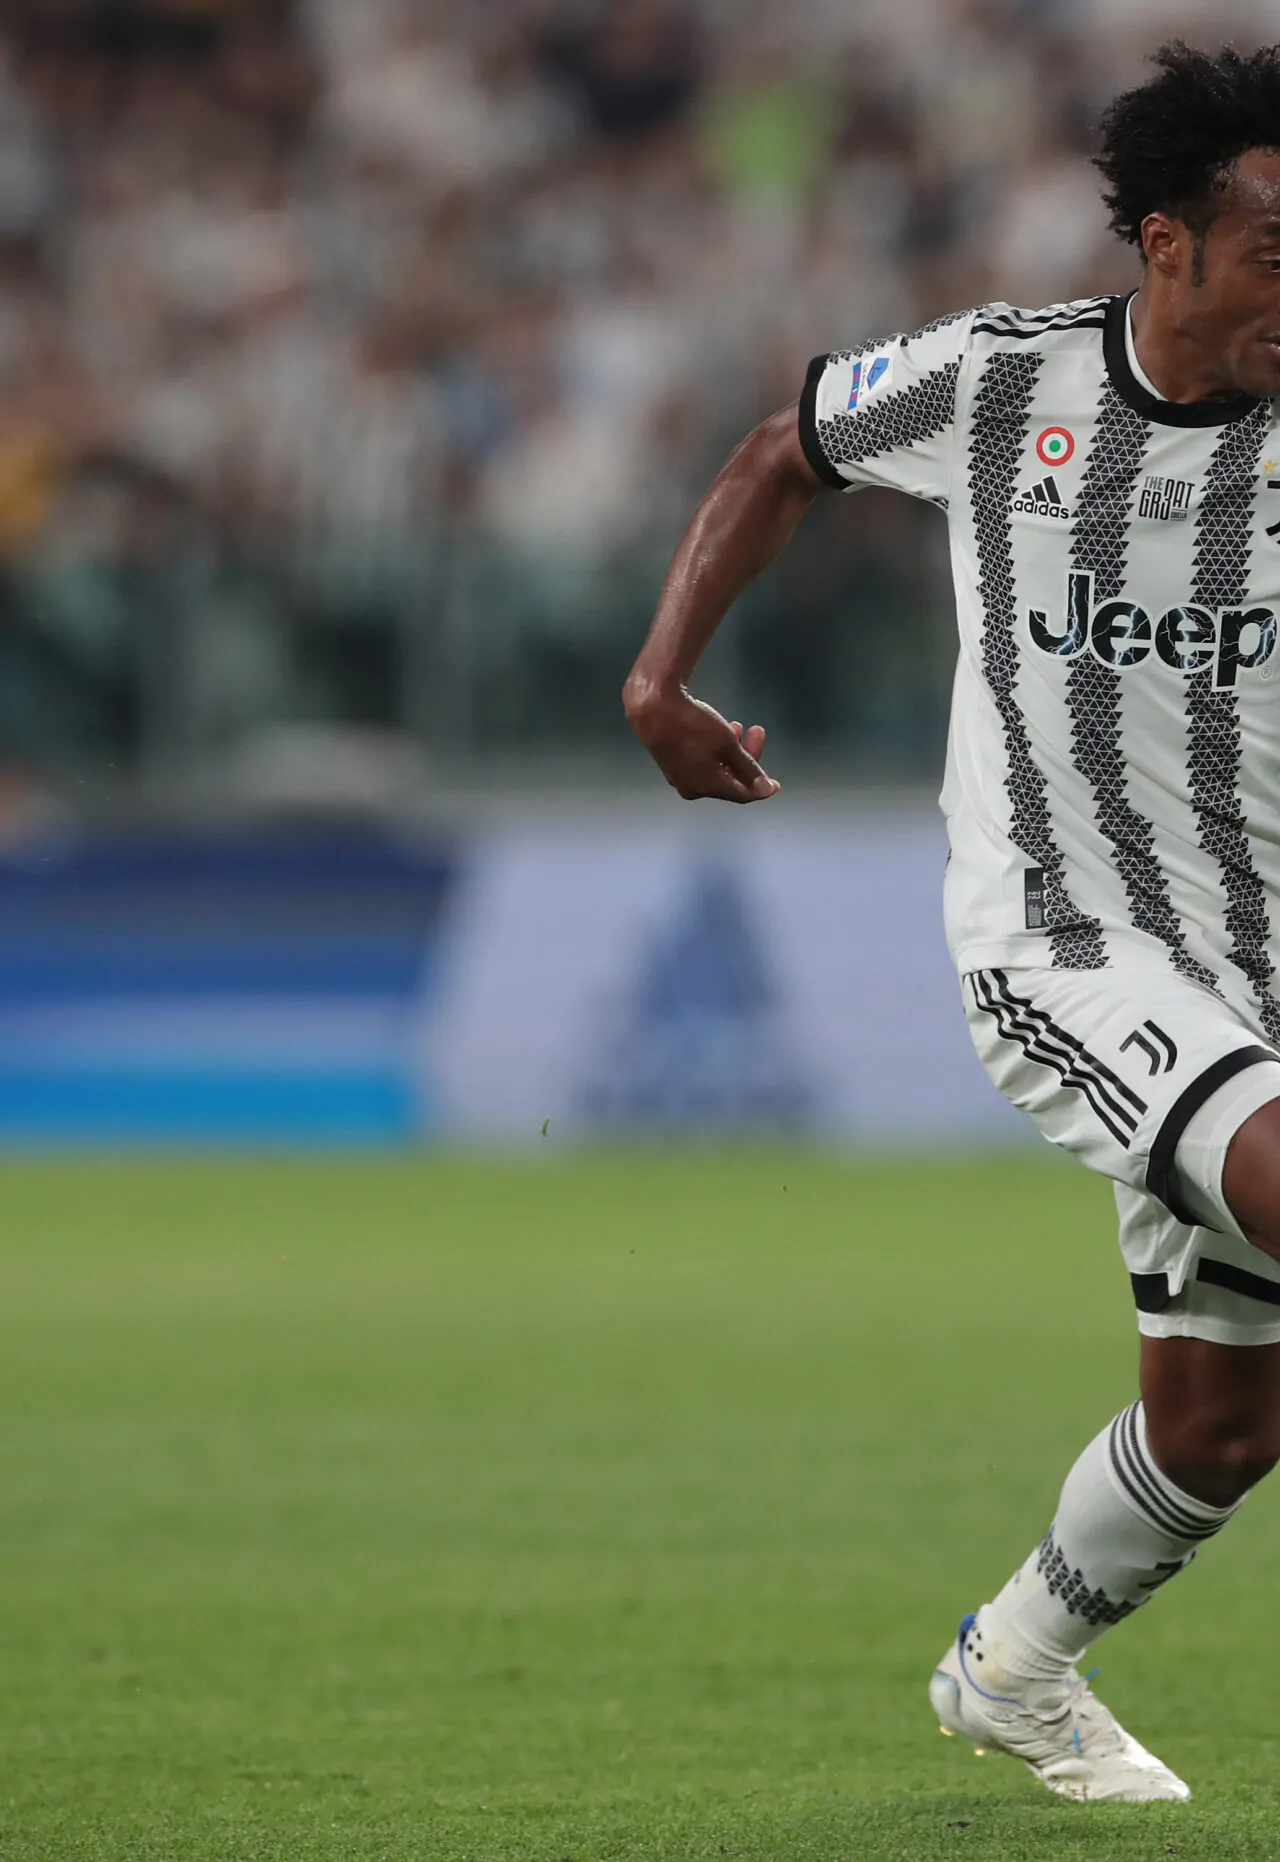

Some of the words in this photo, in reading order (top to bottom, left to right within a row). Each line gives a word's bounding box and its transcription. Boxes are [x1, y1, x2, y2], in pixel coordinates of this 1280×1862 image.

[1143, 475, 1165, 490] THE
[1013, 499, 1070, 519] adidas
[1028, 572, 1278, 689] Jeep
